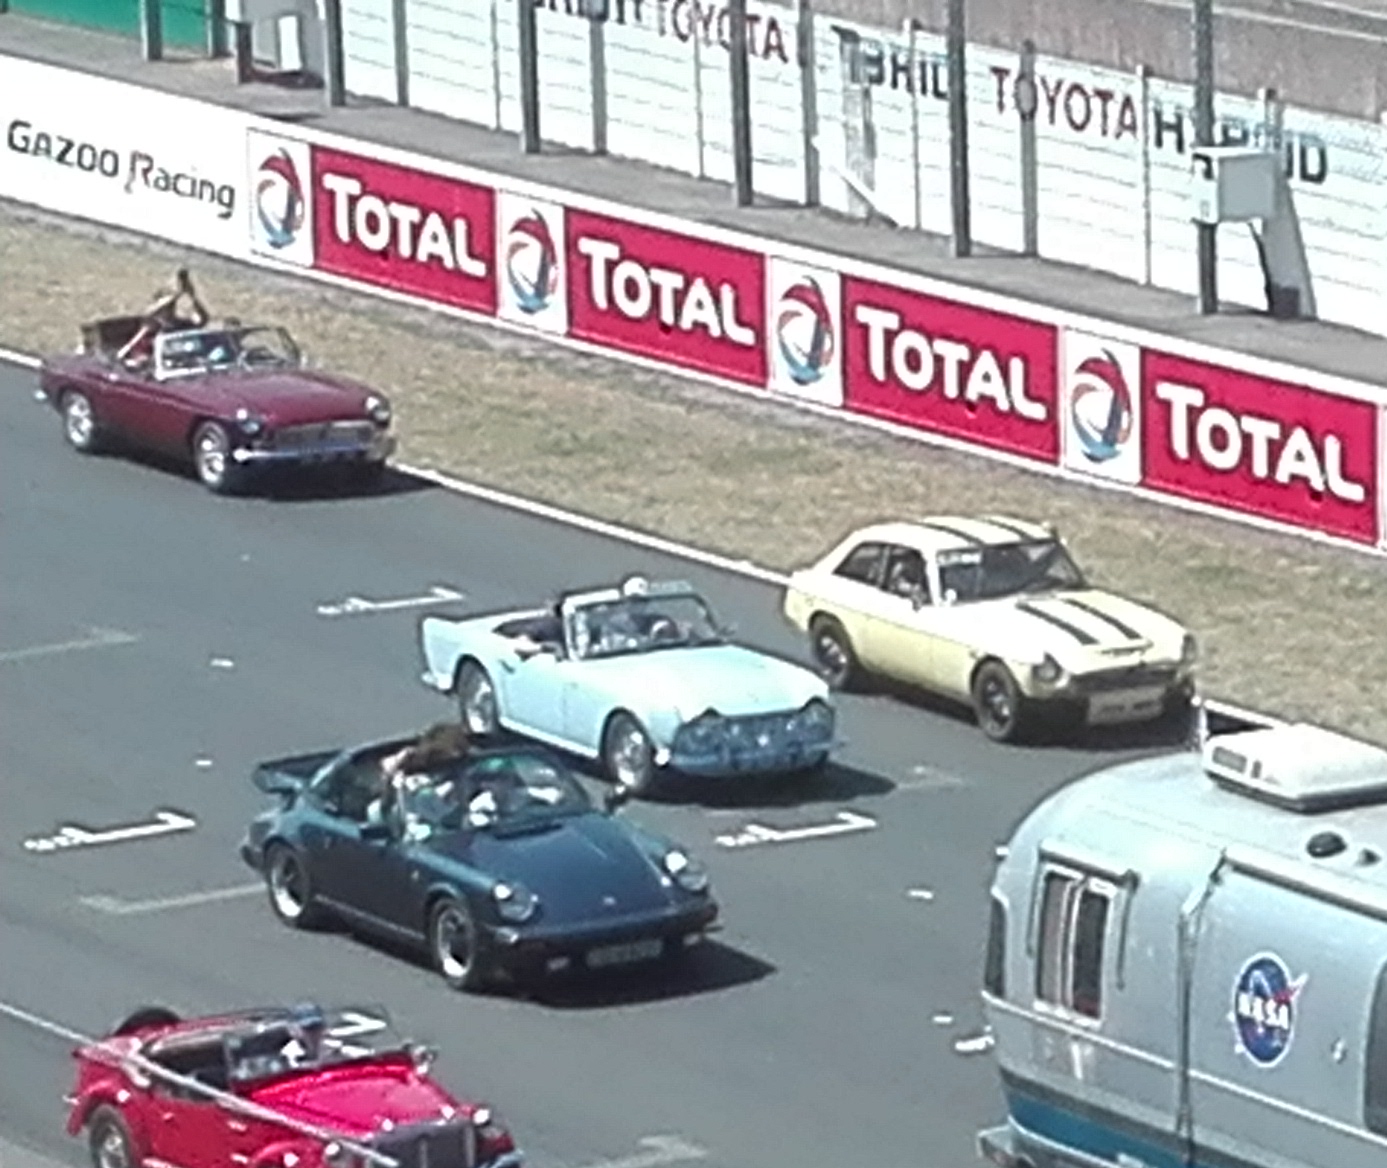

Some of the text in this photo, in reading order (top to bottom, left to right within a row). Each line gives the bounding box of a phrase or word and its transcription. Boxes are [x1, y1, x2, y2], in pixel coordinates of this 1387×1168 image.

[7, 118, 237, 220] GAZOO Racing
[989, 65, 1139, 140] TOYOTA
[1153, 98, 1327, 184] HBID
[320, 171, 488, 278] TOTAL
[576, 235, 757, 347] TOTAL
[854, 303, 1048, 422] TOTAL
[1154, 380, 1366, 503] TOTAL
[1237, 991, 1290, 1031] NASA
